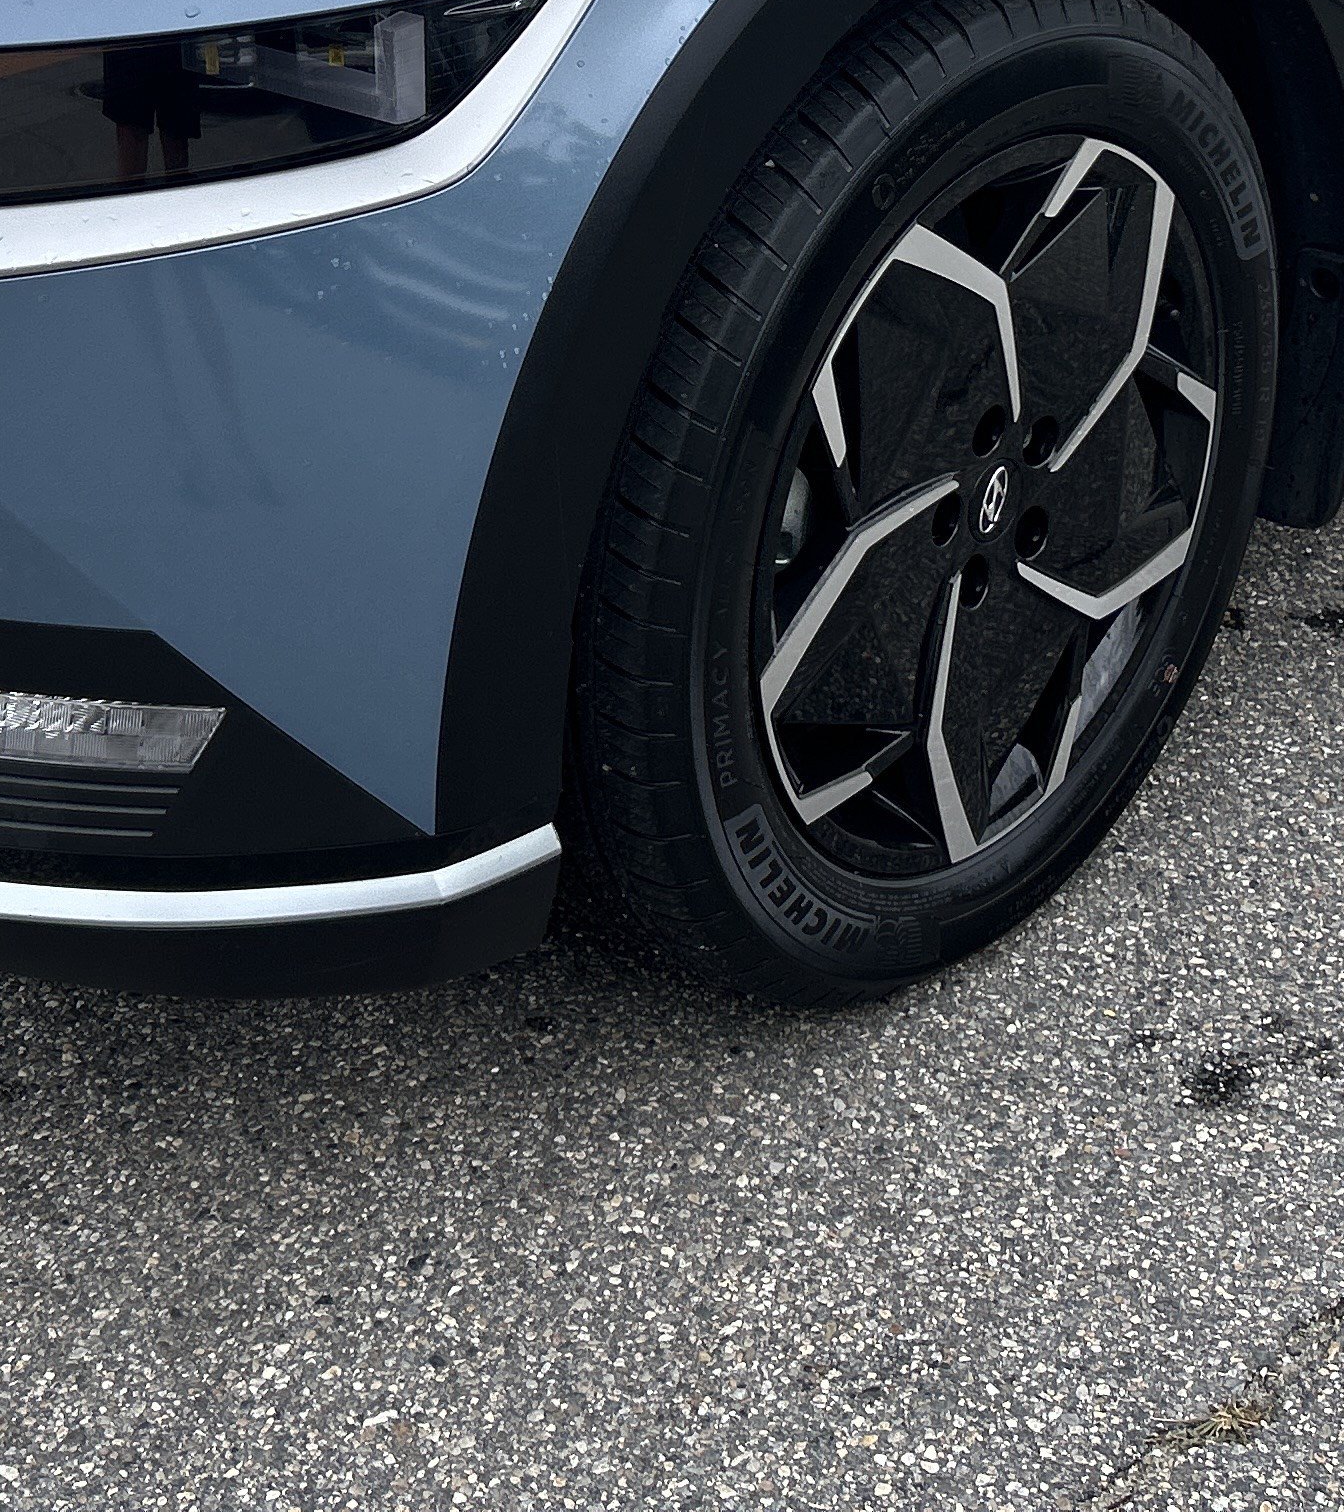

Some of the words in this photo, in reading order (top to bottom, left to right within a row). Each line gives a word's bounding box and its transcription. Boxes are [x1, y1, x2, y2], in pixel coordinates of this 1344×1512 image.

[1167, 89, 1262, 249] MICHELIN
[711, 638, 739, 788] PRIMACY
[734, 817, 871, 953] MICHELIN
